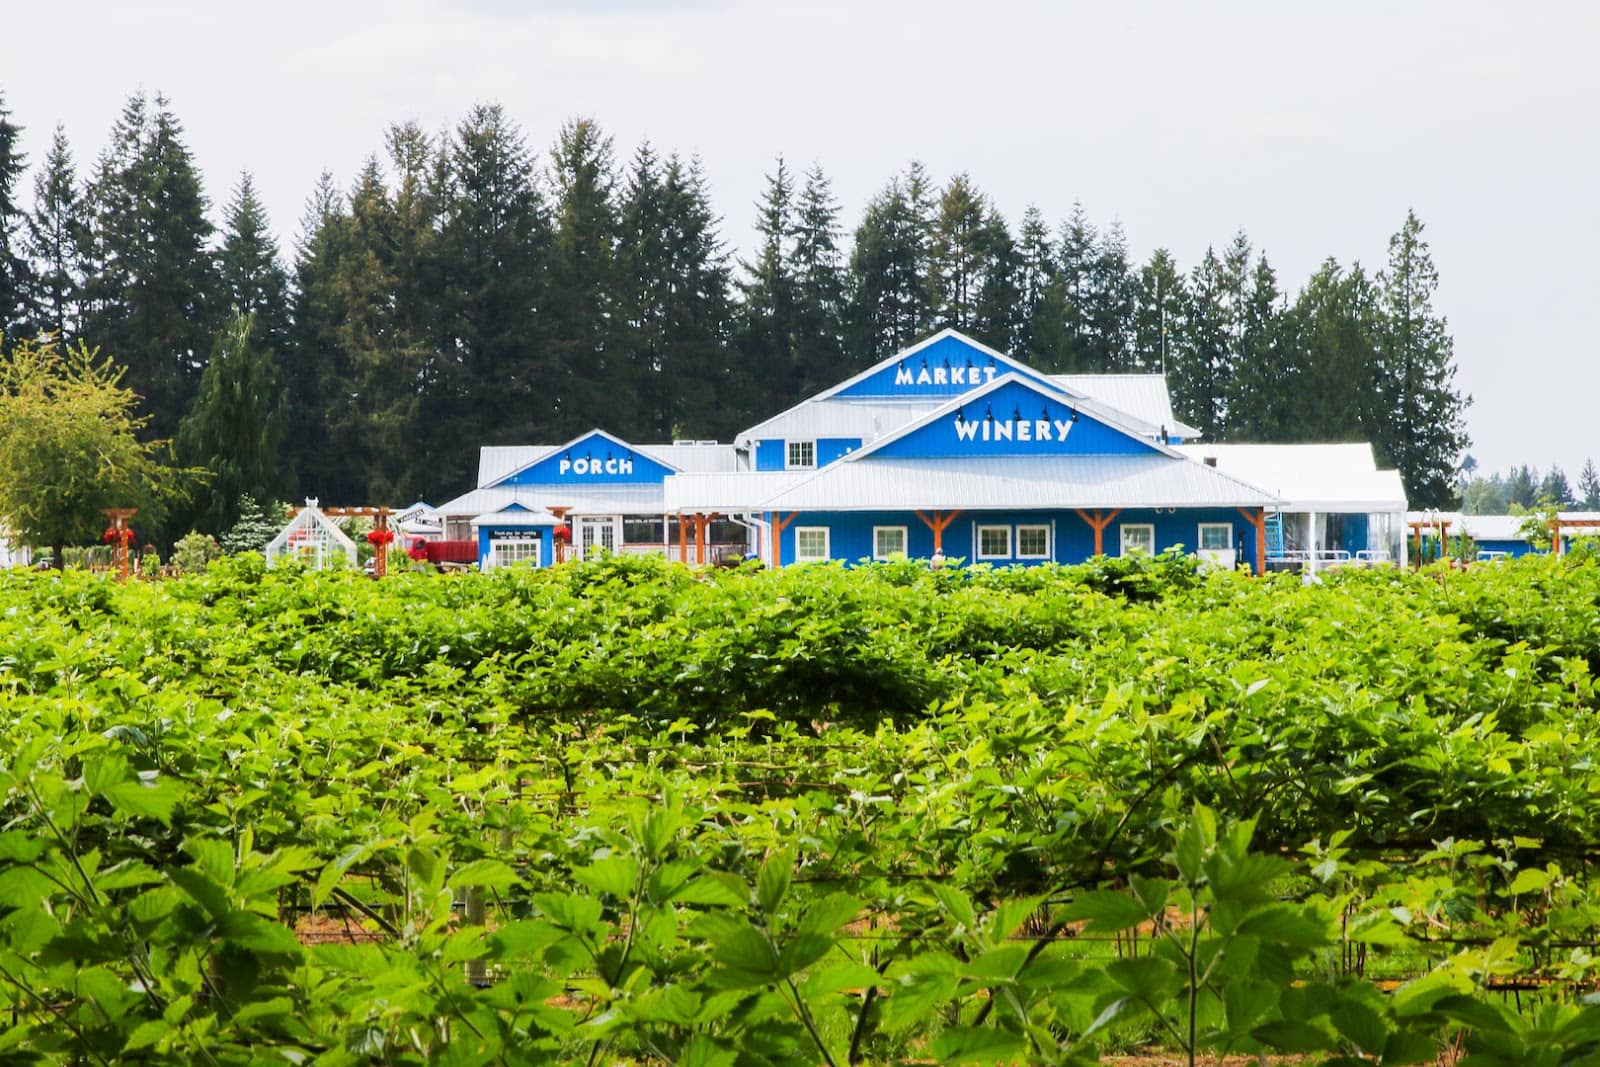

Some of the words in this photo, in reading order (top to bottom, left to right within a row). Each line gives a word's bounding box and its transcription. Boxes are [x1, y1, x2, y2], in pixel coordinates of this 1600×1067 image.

[895, 367, 997, 385] MARKET
[954, 420, 1073, 441] WINERY
[559, 459, 633, 475] PORCH
